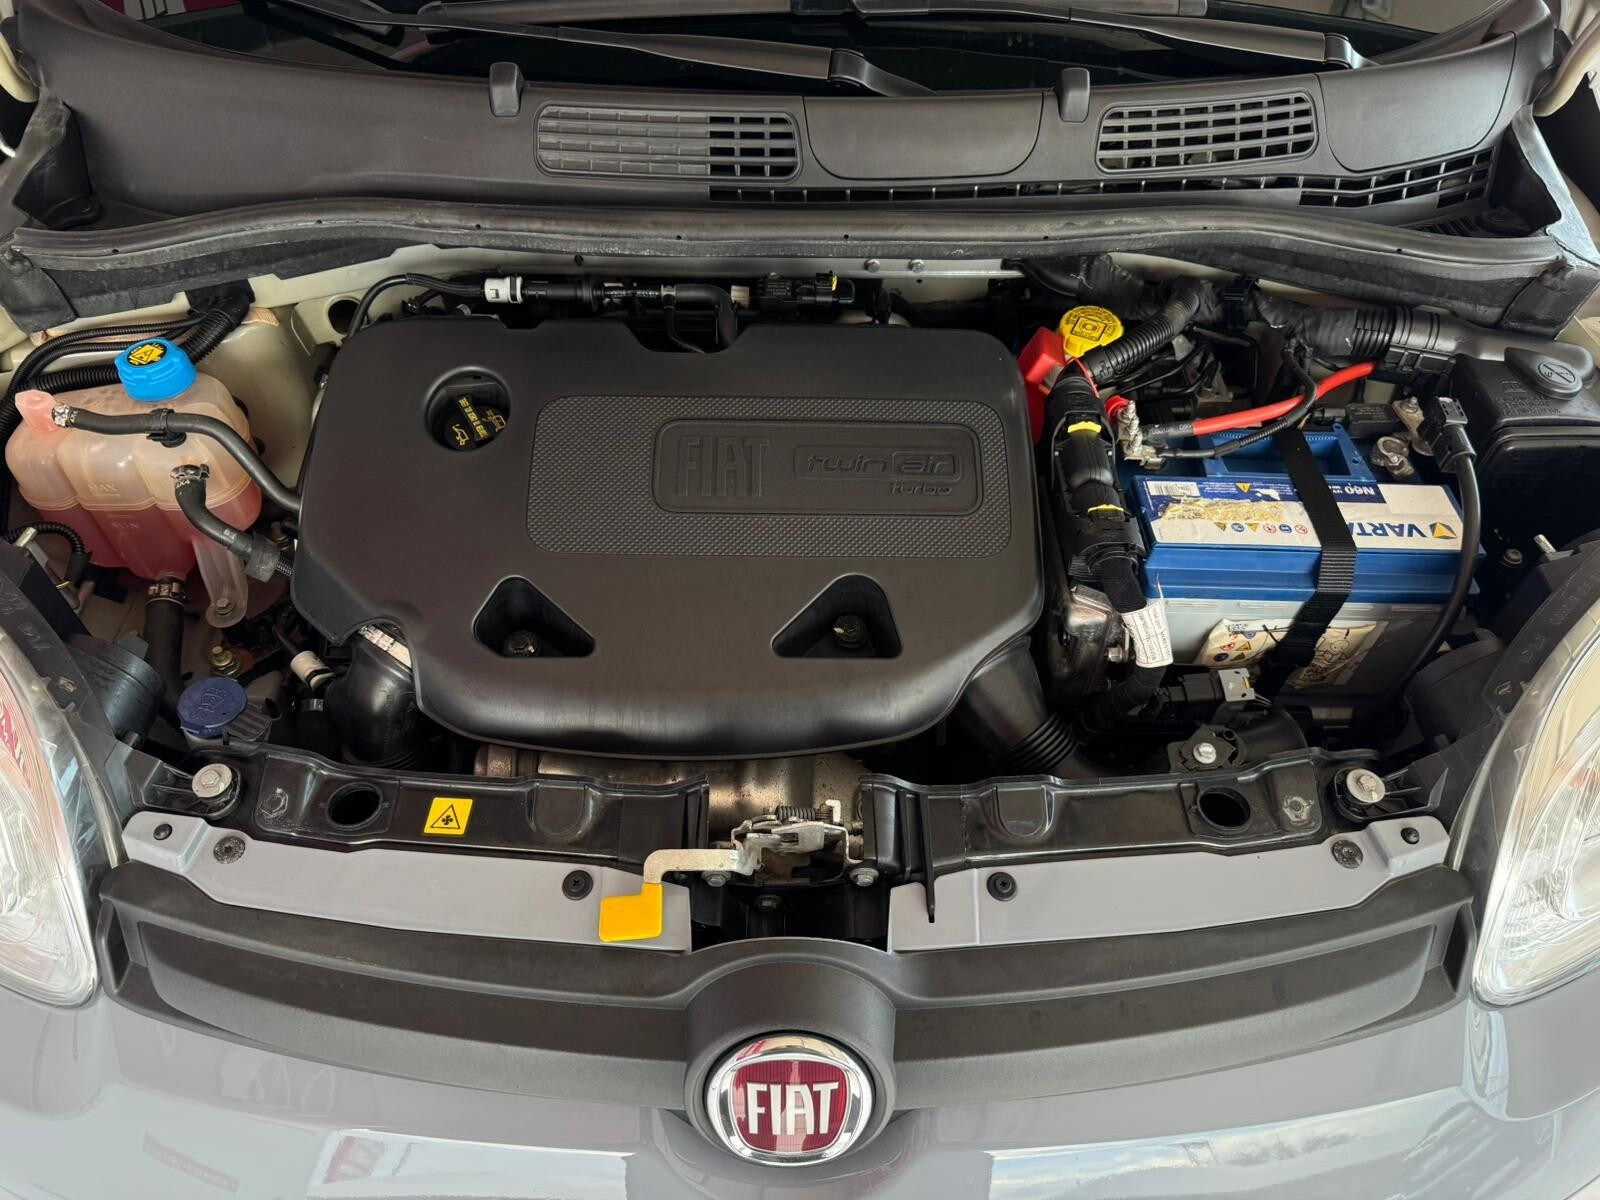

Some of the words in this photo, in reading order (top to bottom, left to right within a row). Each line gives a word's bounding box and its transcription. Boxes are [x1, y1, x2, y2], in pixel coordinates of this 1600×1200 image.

[677, 436, 770, 498] FIAT
[807, 453, 888, 473] twin
[901, 456, 949, 474] air
[890, 481, 952, 496] turbo
[1344, 485, 1375, 495] N60
[746, 1081, 839, 1136] FIAT
